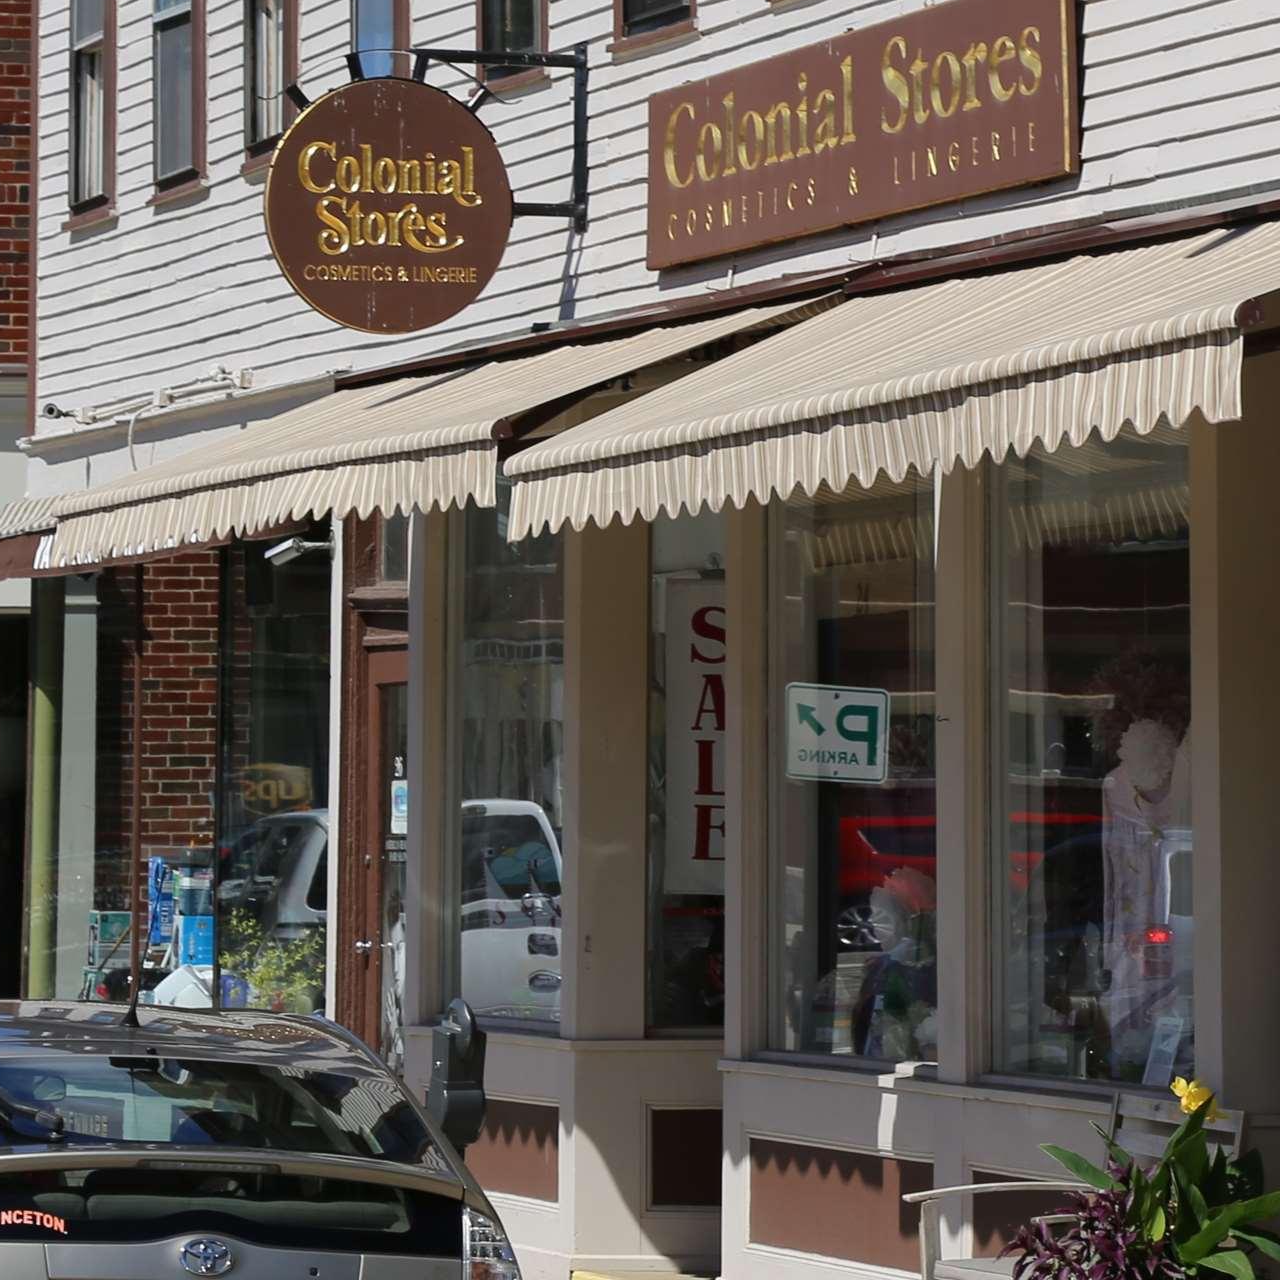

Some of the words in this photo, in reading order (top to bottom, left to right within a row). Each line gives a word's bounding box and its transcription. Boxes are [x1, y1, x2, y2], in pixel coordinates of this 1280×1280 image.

[663, 55, 856, 189] Colonial
[880, 25, 1044, 135] Stores
[297, 140, 483, 207] Colonial
[668, 175, 817, 241] COSMETICS
[847, 166, 860, 197] &
[892, 121, 1037, 186] LINGERIE
[315, 195, 465, 256] Stores
[303, 264, 393, 282] COSMETICS
[397, 266, 409, 283] &
[413, 267, 478, 284] LINGERIE
